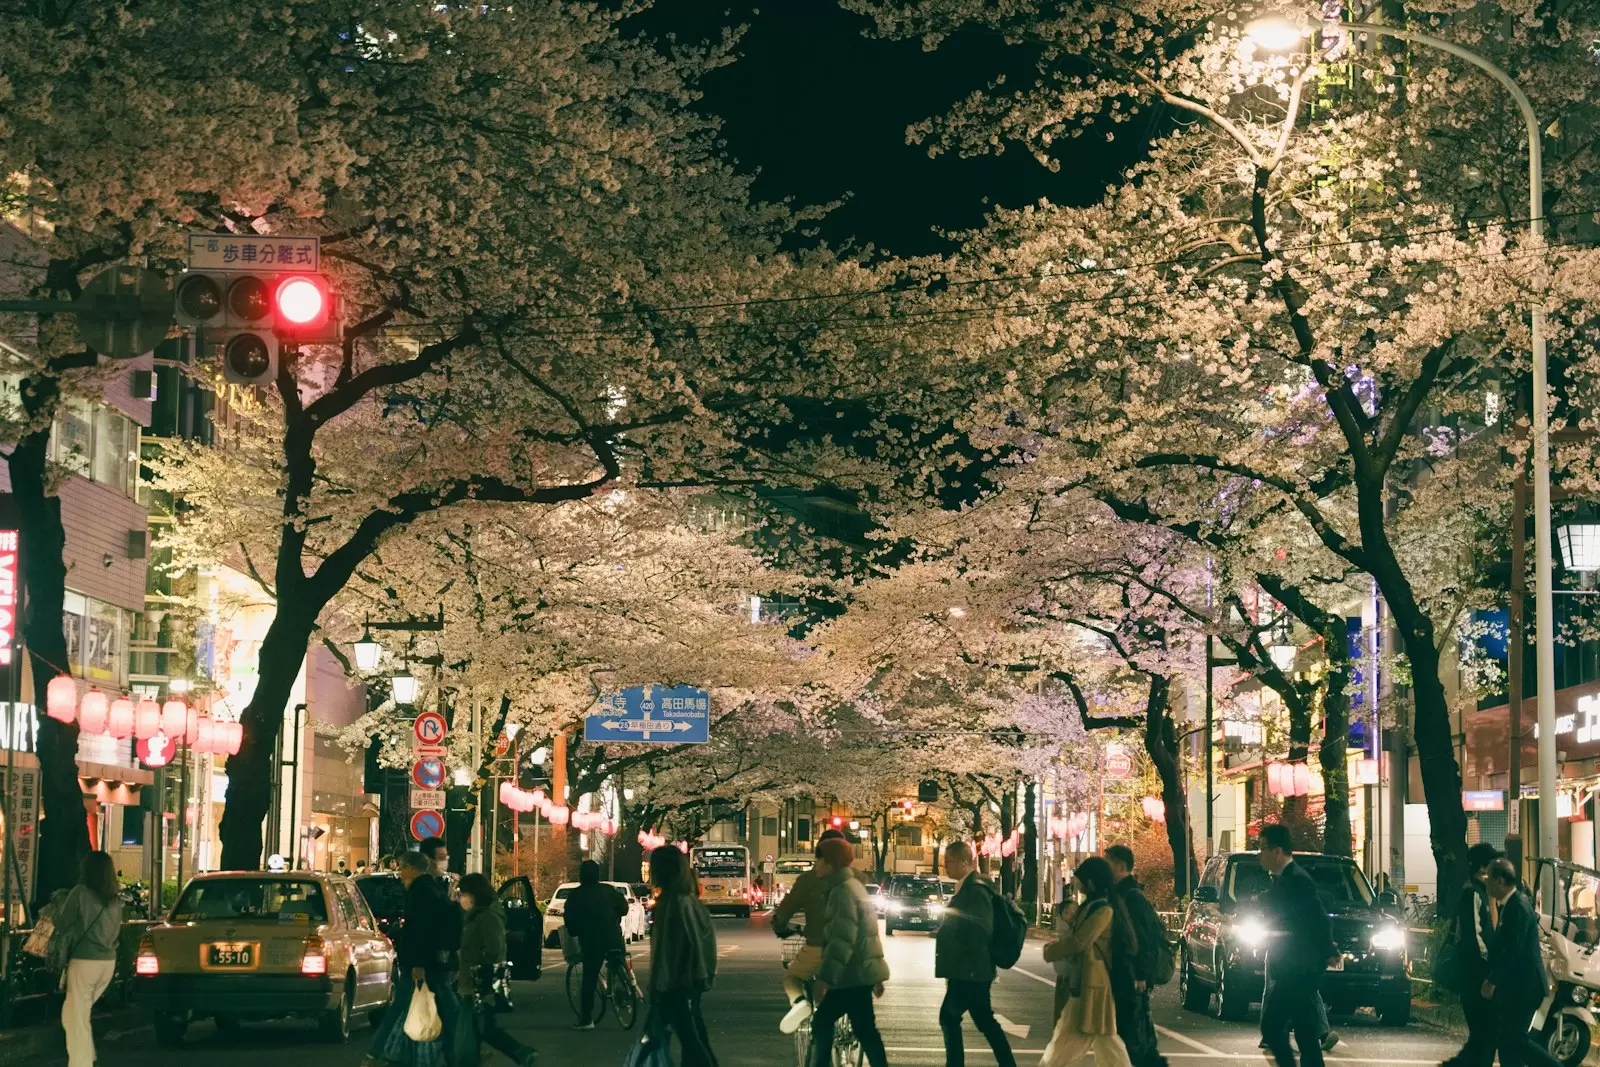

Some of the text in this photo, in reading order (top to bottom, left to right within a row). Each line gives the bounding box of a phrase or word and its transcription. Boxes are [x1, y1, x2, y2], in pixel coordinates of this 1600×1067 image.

[642, 702, 653, 710] 420
[661, 698, 706, 710] 高田馬場
[663, 710, 706, 718] Takadanobaba
[631, 722, 670, 730] 早稲田通り
[219, 952, 249, 964] 55-10
